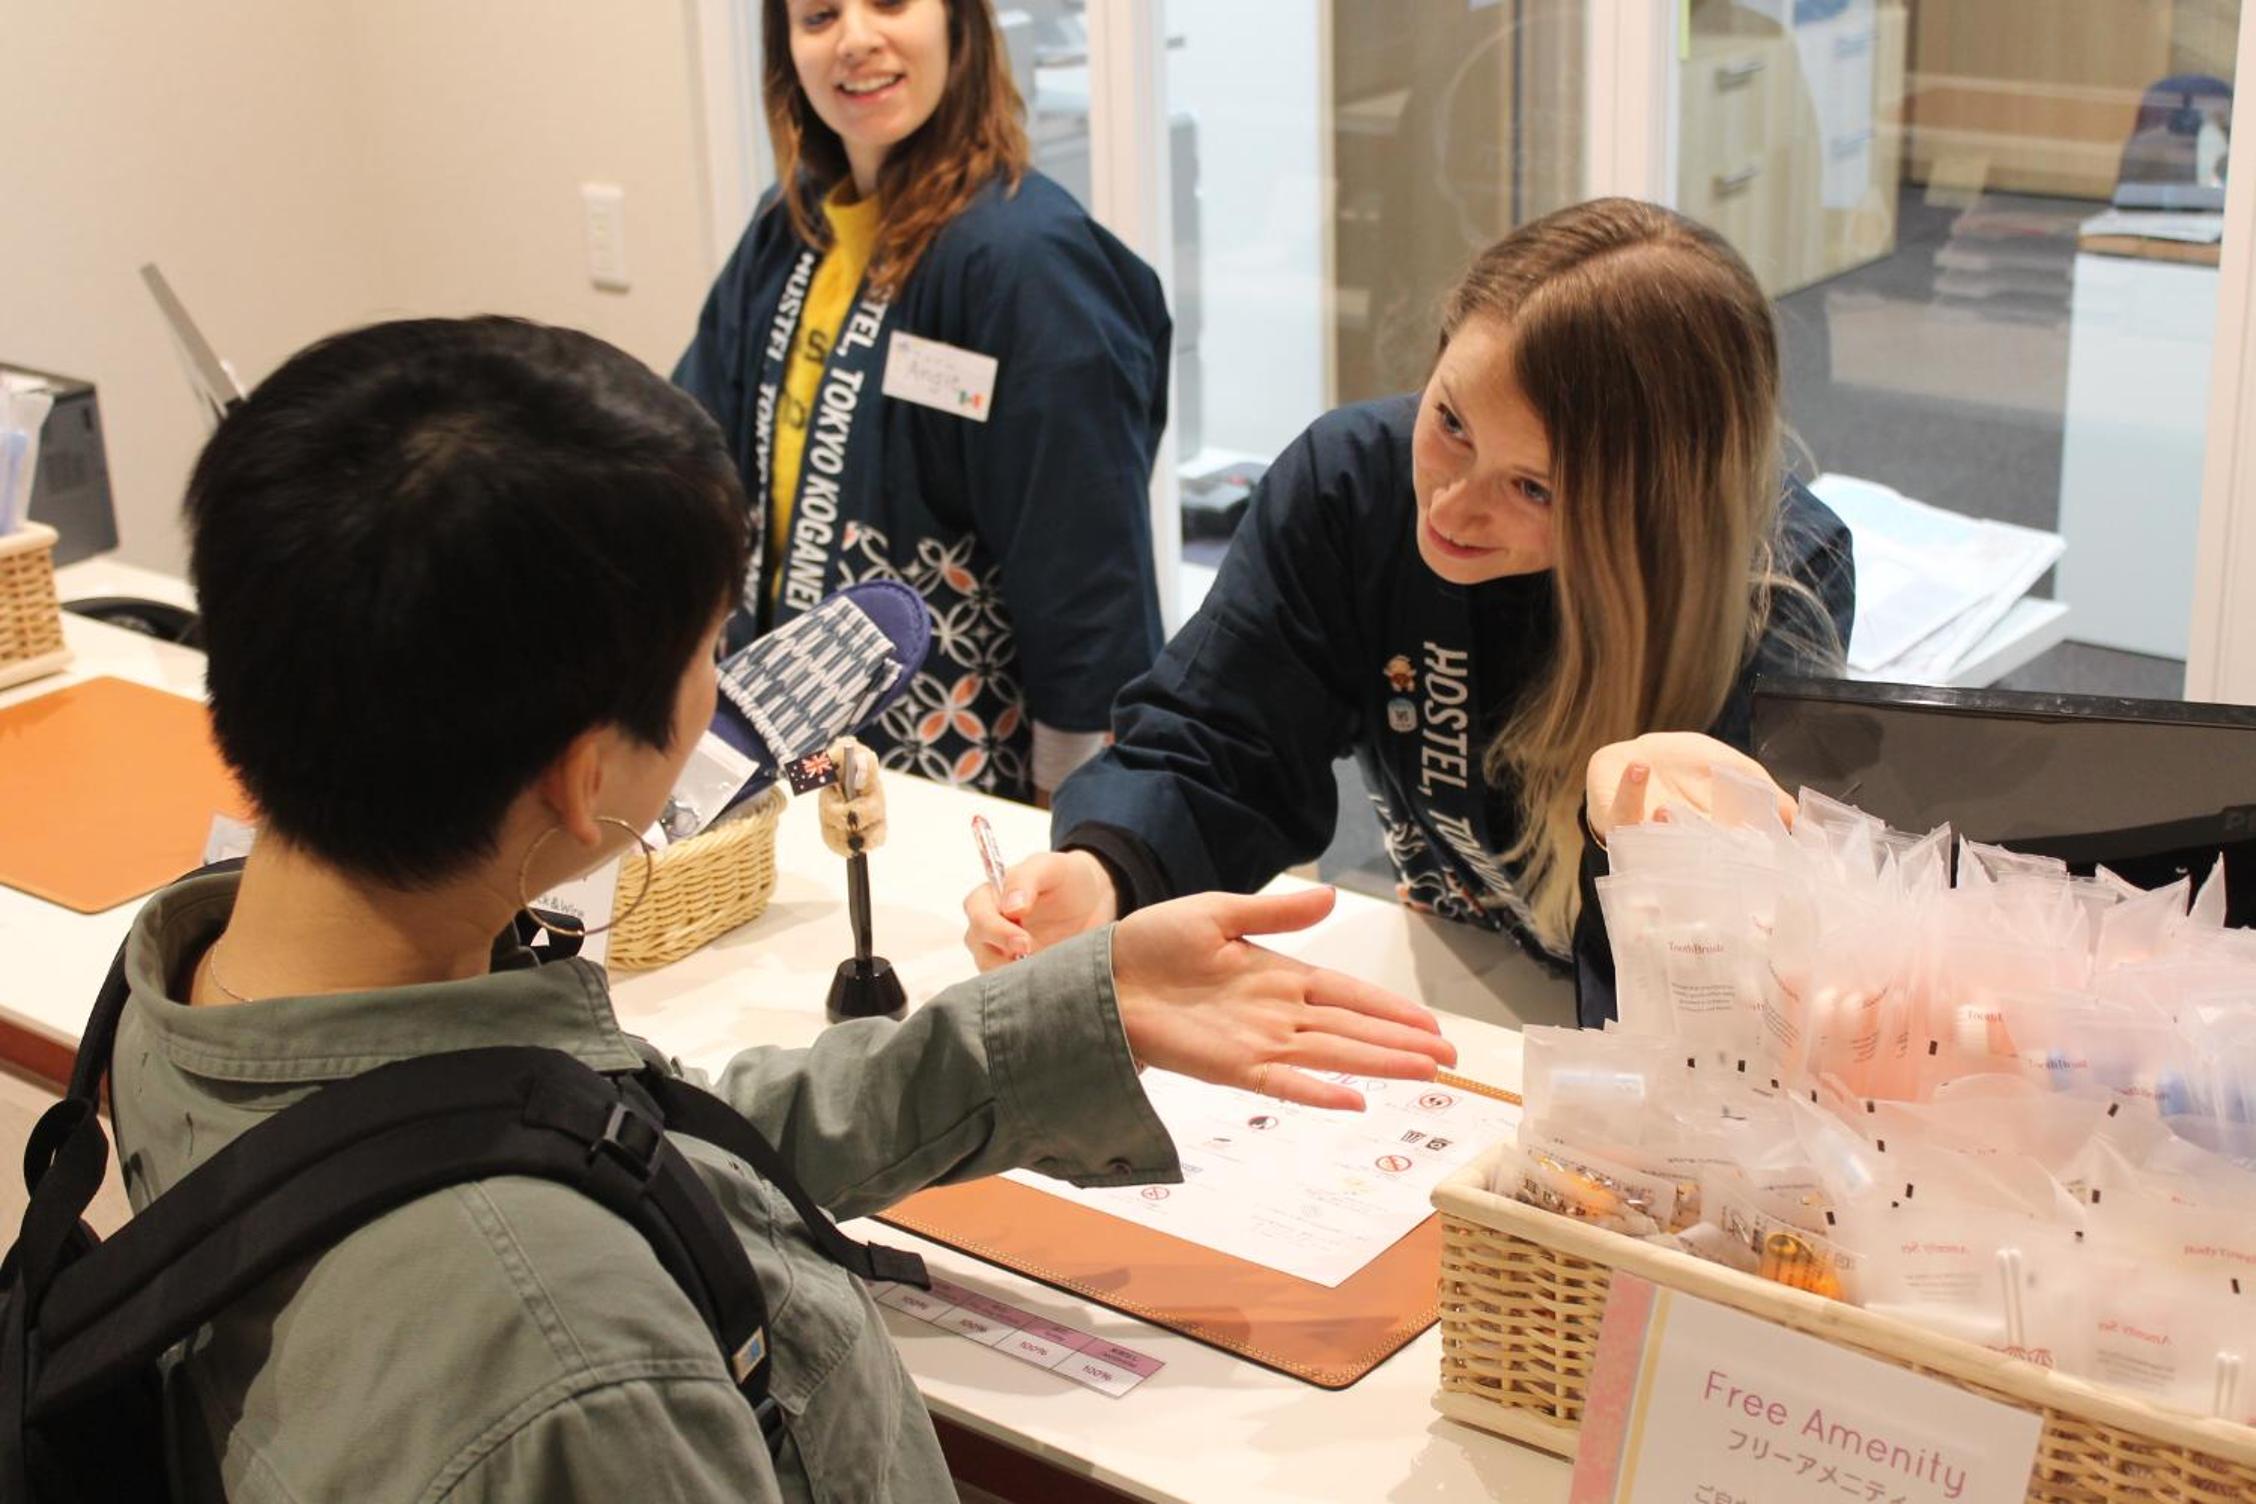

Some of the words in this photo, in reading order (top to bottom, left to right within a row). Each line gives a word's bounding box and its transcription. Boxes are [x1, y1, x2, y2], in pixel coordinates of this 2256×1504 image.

[811, 367, 865, 476] TOKYO
[785, 474, 840, 612] KOGANEI
[1417, 641, 1468, 796] HOSTEL,
[1020, 1340, 1048, 1357] 100%
[1082, 1363, 1113, 1382] 100%
[1704, 1369, 1789, 1426] Free
[1801, 1408, 1967, 1500] Amenity
